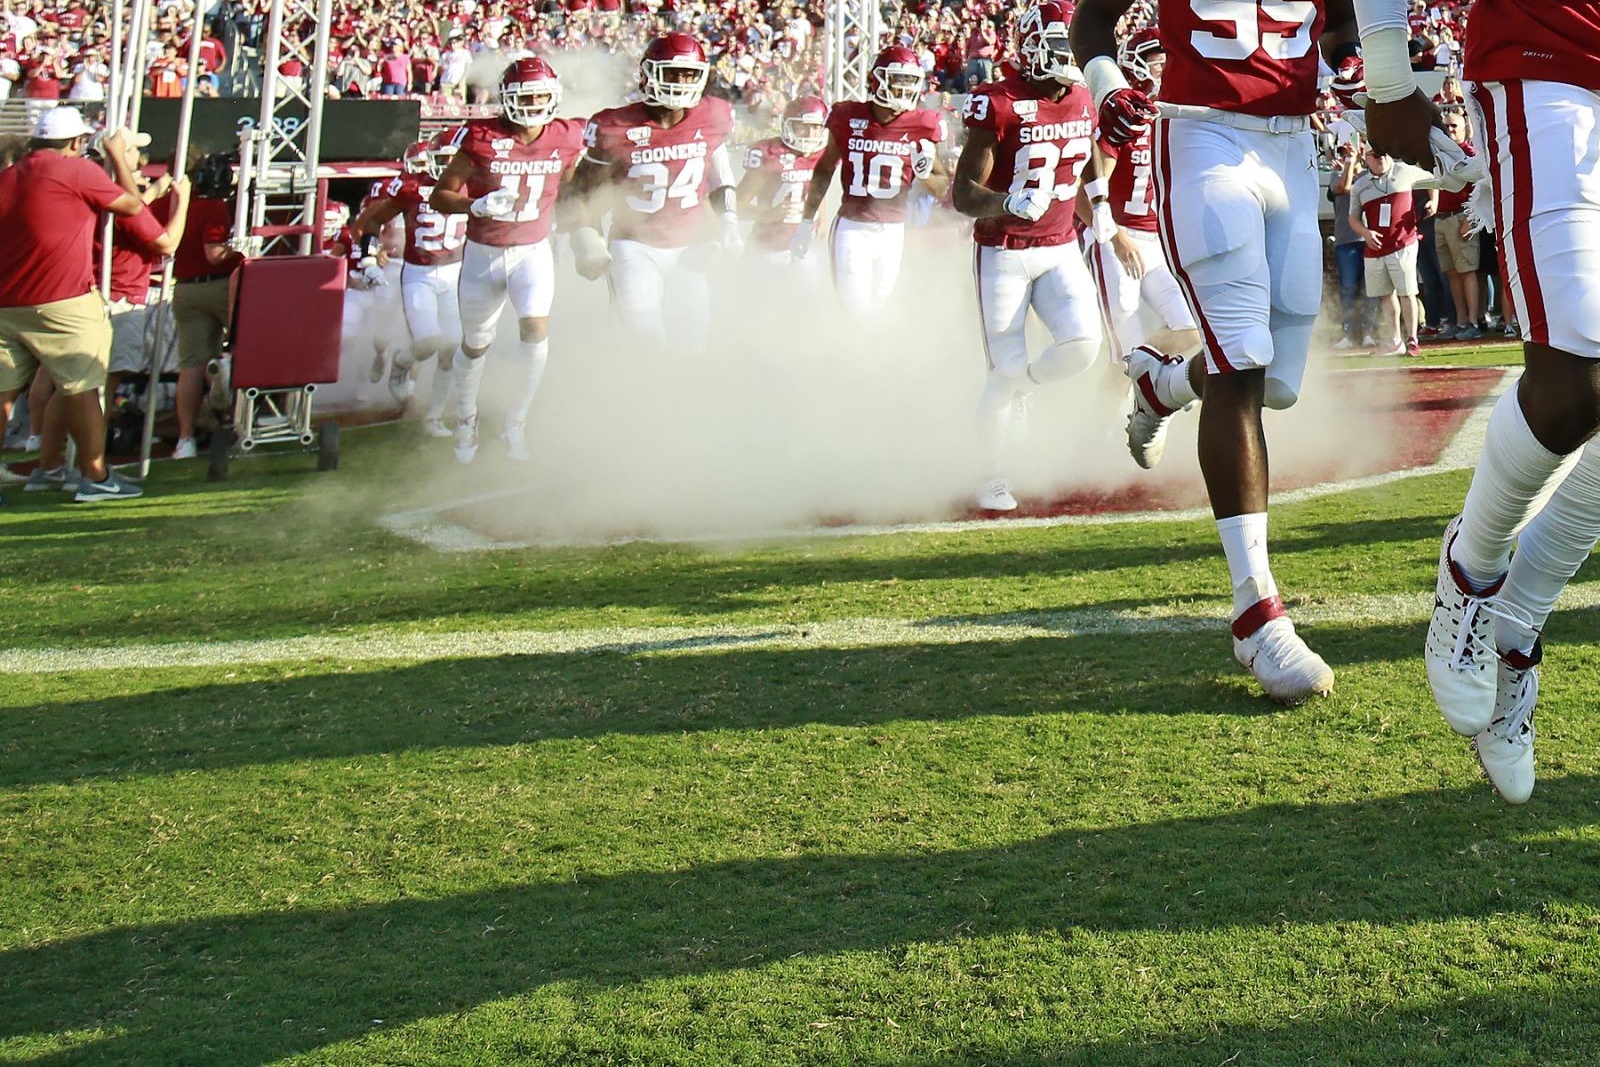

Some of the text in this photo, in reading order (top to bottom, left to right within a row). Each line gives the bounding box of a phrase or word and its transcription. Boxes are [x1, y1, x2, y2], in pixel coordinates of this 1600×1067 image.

[1020, 120, 1092, 143] SOONERS
[631, 141, 706, 165] SOONERS
[848, 138, 910, 156] SOONERS
[490, 160, 562, 173] SOONERS
[848, 151, 905, 199] 10
[625, 157, 704, 213] 34
[415, 213, 469, 250] 20
